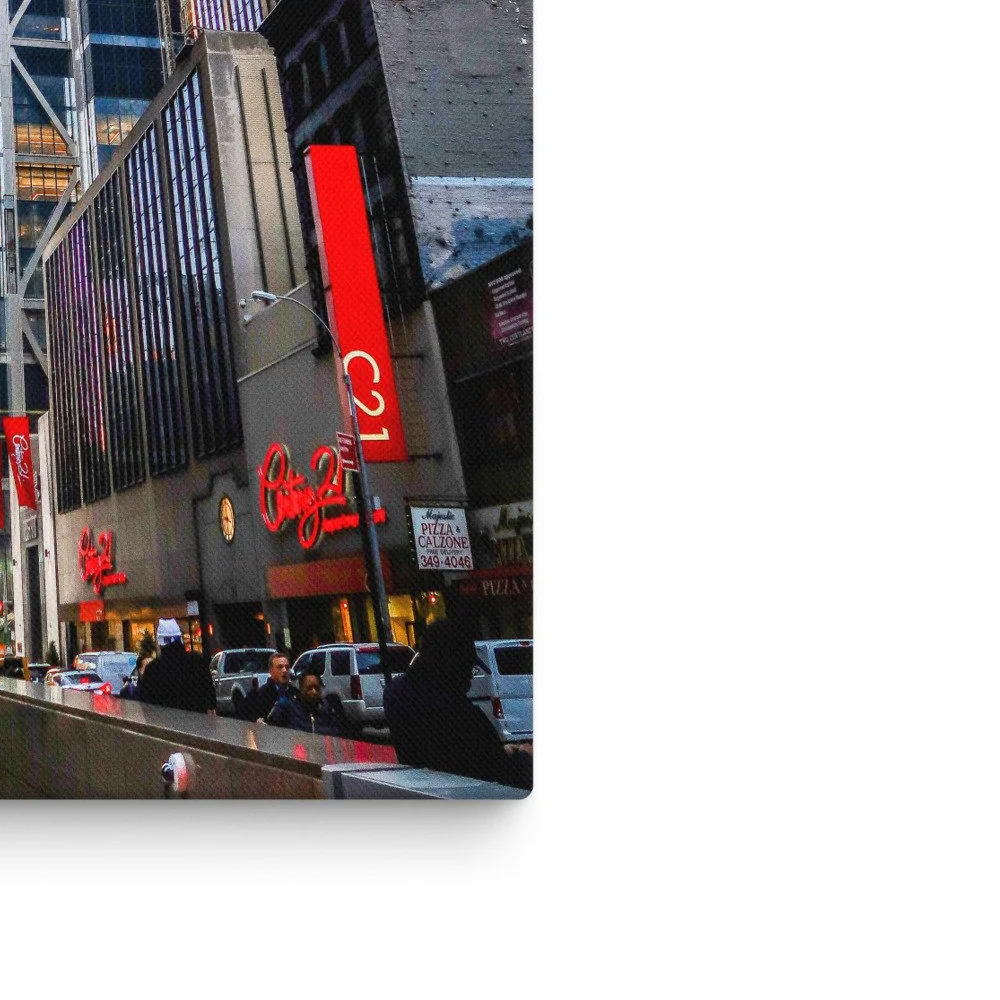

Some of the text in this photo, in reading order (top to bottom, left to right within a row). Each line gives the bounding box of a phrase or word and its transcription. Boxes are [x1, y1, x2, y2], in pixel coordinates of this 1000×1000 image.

[342, 350, 390, 441] C21
[421, 522, 454, 536] PIZZA
[418, 535, 469, 549] CALZONE
[482, 579, 521, 596] PIZZA
